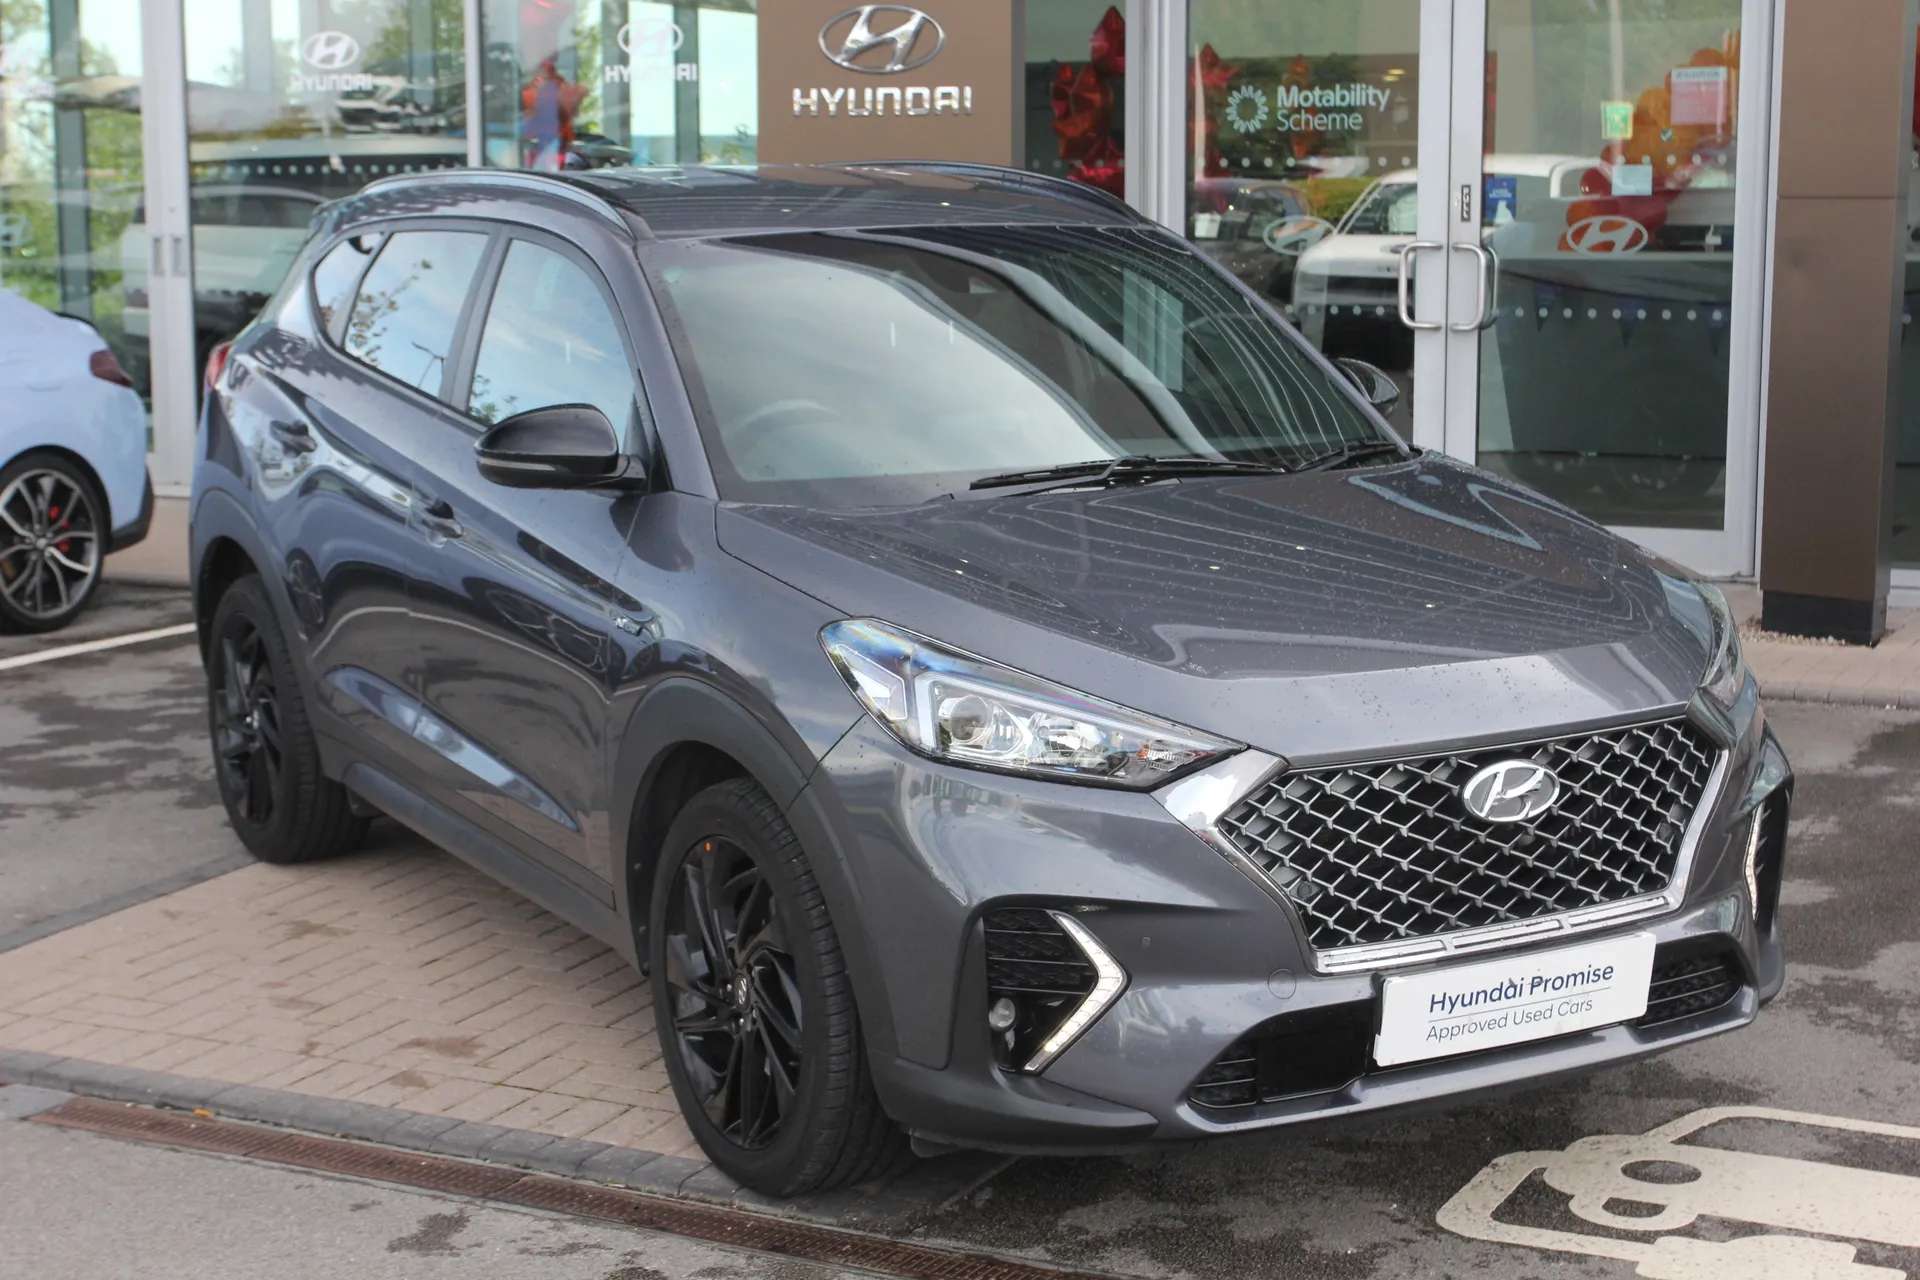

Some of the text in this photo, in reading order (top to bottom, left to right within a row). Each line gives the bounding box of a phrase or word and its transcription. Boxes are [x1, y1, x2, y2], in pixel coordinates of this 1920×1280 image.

[604, 63, 698, 82] HYAI
[792, 85, 972, 116] HYUNDAI
[1277, 83, 1391, 112] Motability
[1277, 109, 1363, 131] Scheme
[1429, 964, 1614, 1014] Hyundai Promise
[1426, 998, 1593, 1043] Approved Used Cars
